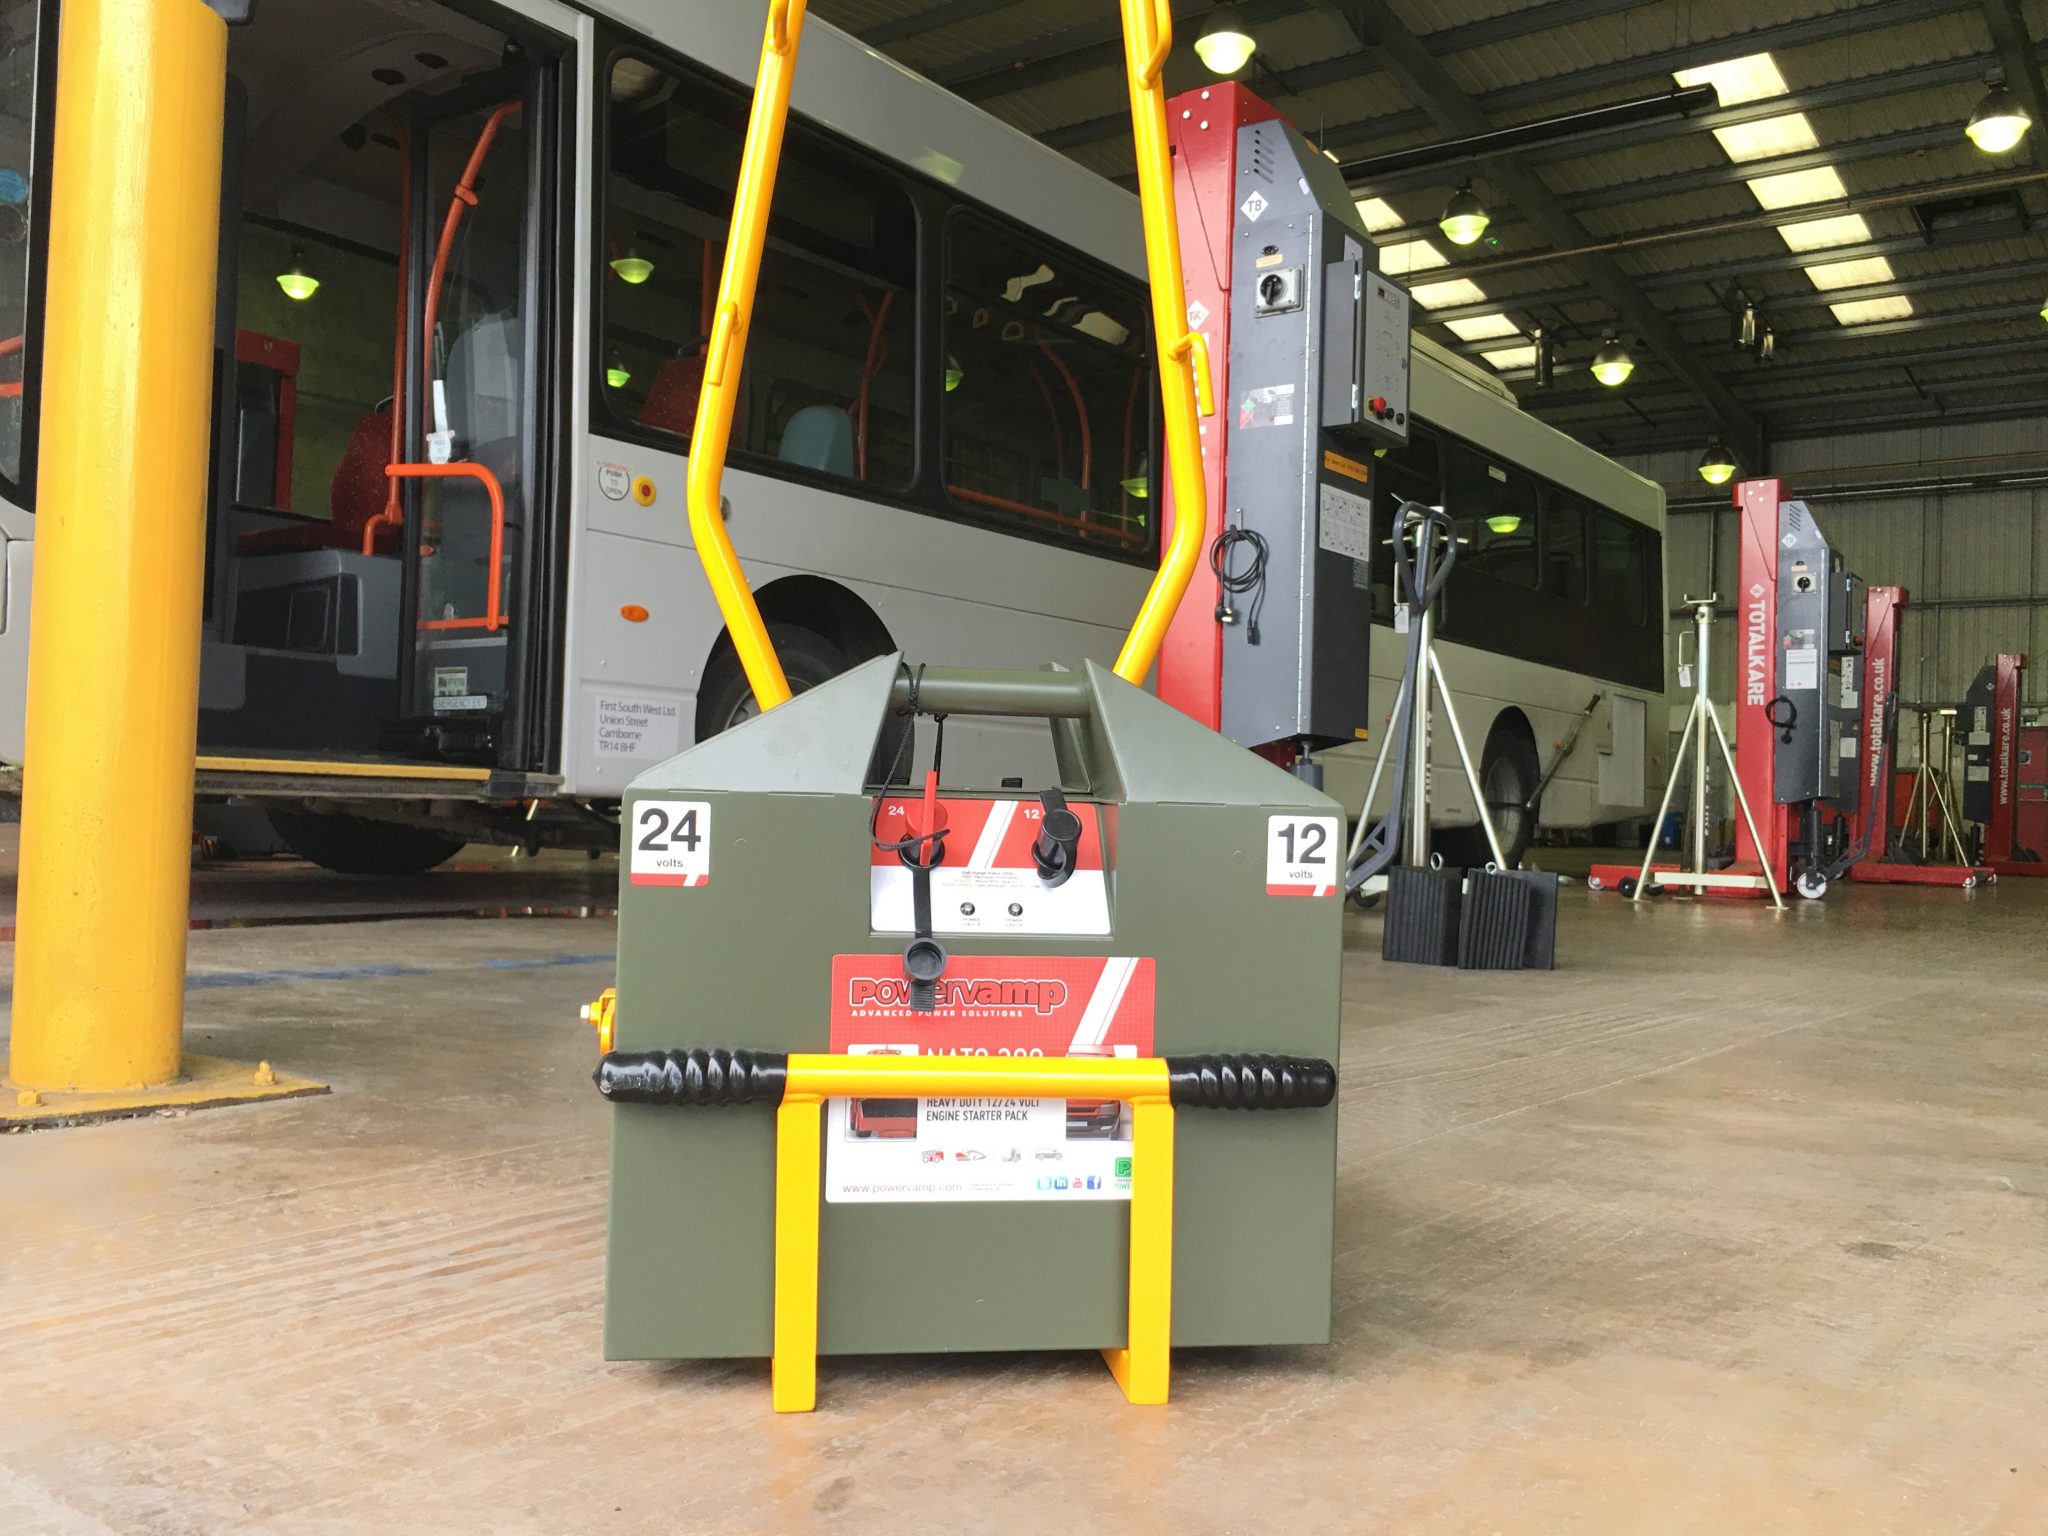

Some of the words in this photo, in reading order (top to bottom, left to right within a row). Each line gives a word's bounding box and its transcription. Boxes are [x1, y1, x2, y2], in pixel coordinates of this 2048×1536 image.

[1247, 199, 1263, 213] T8
[605, 469, 623, 478] PUSH
[1747, 600, 1766, 706] TOTALKARE
[600, 700, 617, 712] First
[618, 702, 641, 714] South
[642, 704, 662, 716] West
[600, 714, 625, 725] Union
[625, 716, 649, 728] Street
[599, 740, 619, 751] TR14
[620, 742, 637, 753] 8HF
[1999, 707, 2012, 805] www.totalkare.co.uk
[888, 806, 905, 816] 24
[1024, 809, 1040, 819] 12
[638, 807, 702, 852] 24
[1277, 822, 1327, 864] 12
[656, 858, 684, 868] volts
[1289, 870, 1313, 879] volts
[851, 1009, 912, 1017] ADVANCED
[926, 1097, 956, 1108] HEAVY
[959, 1097, 983, 1108] DUTY
[926, 1110, 960, 1121] ENGINE
[963, 1110, 1002, 1121] STARTER
[1005, 1110, 1028, 1121] PACK
[842, 1183, 963, 1194] www.powervamp.com
